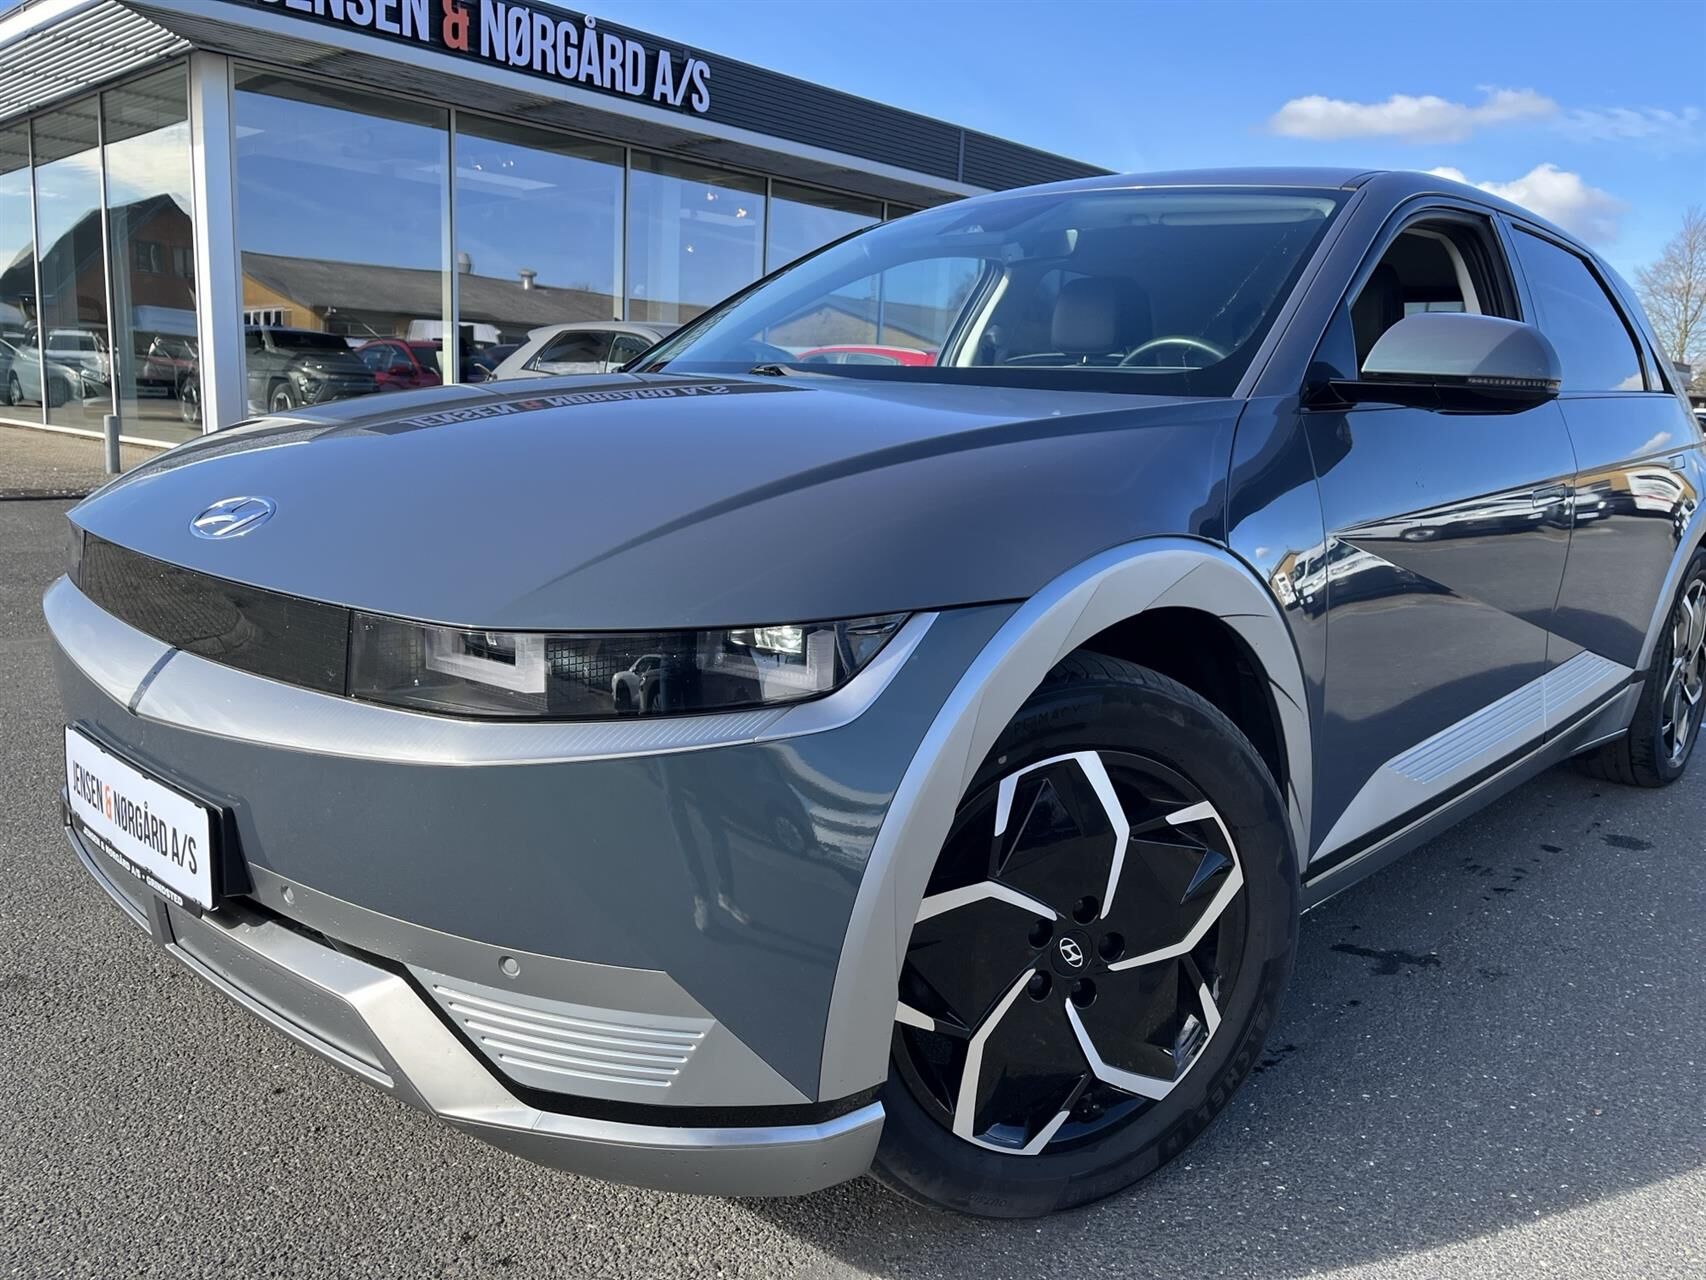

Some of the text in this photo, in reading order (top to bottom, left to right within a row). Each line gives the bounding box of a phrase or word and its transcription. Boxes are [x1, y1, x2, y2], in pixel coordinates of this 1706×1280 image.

[443, 0, 469, 51] &
[480, 0, 646, 96] NØRGÅRD
[653, 49, 711, 113] A/S
[72, 759, 104, 814] JENSEN
[104, 784, 112, 821] &
[113, 790, 167, 856] NØRGÅRD
[171, 827, 198, 875] A/S
